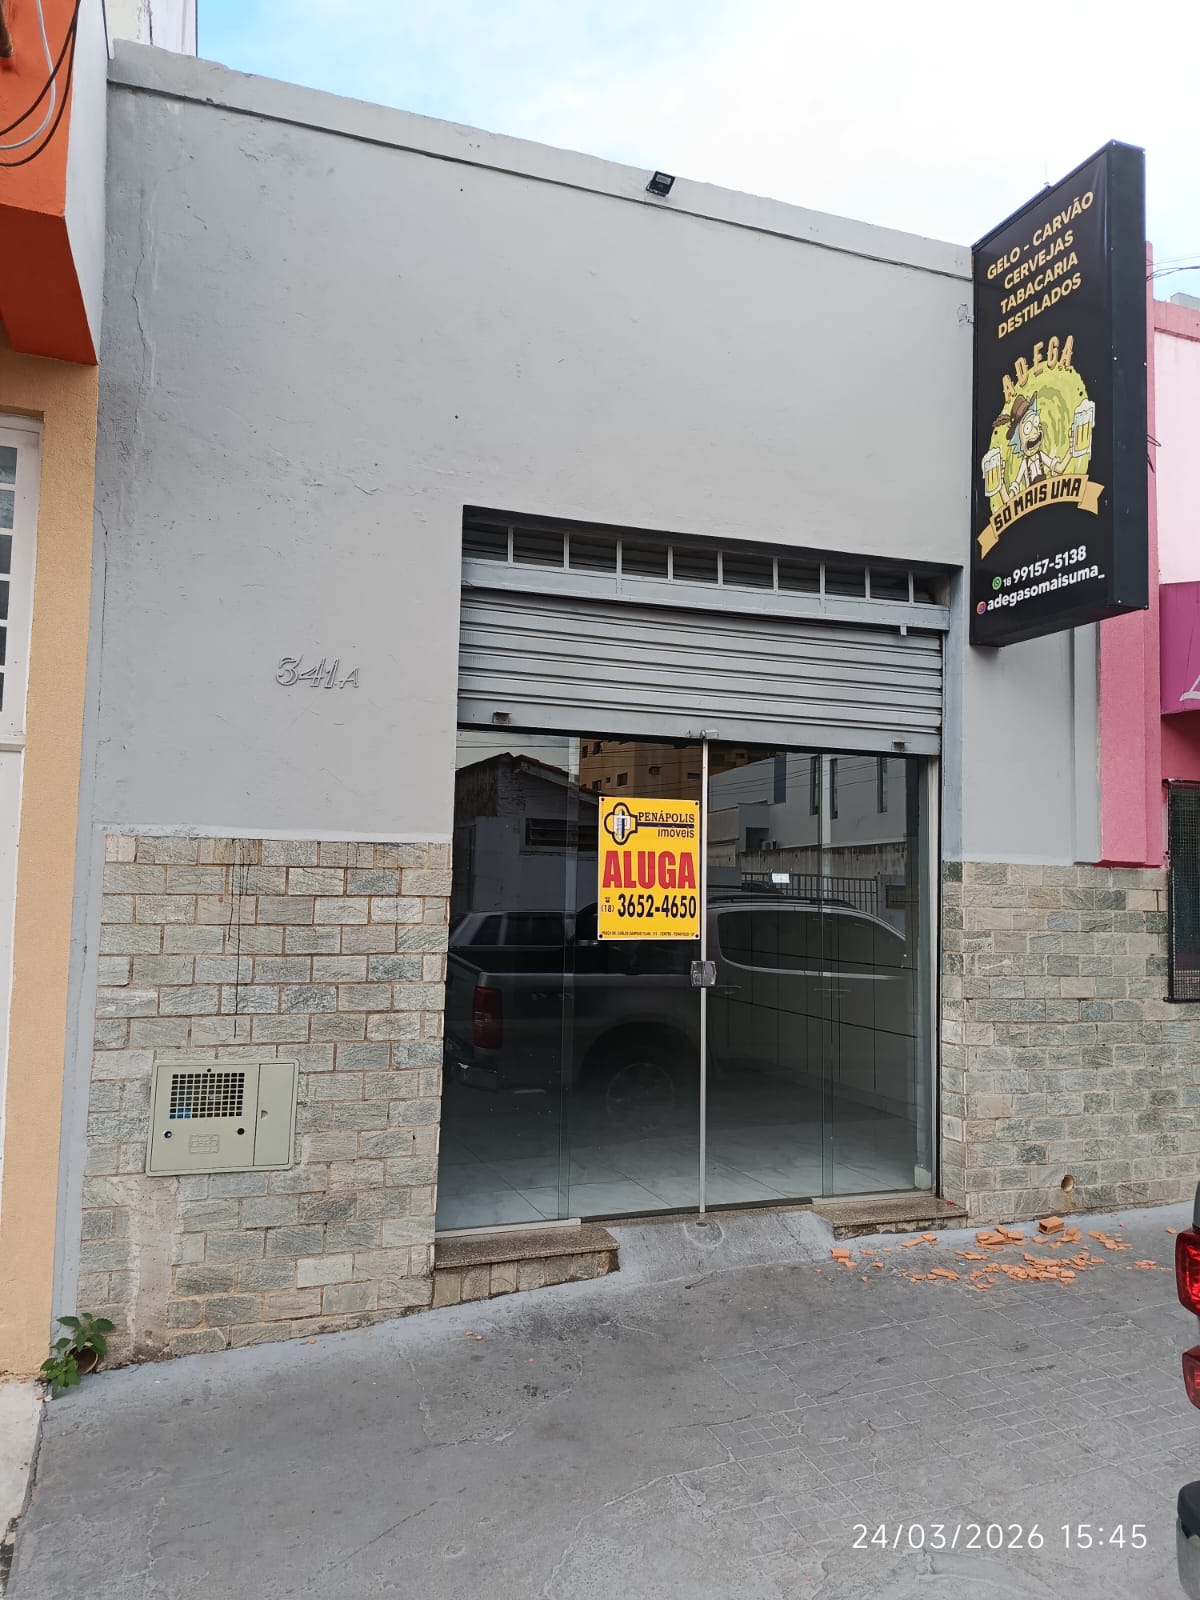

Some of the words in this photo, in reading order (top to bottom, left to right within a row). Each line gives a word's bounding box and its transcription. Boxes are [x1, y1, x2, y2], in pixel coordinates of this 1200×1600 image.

[987, 246, 1020, 280] GELO
[1032, 191, 1094, 246] CARVÃO
[1004, 230, 1074, 289] CERVEJAS
[1000, 251, 1079, 314] TABACARIA
[998, 273, 1082, 339] DESTILADOS
[1002, 335, 1074, 403] ADEGA
[1014, 483, 1048, 515] MAIS
[1051, 477, 1082, 499] UMA
[987, 565, 1105, 611] adegasomaisuma_
[1003, 577, 1012, 588] 18
[1012, 545, 1087, 583] 99157-5138
[638, 810, 695, 824] PENÁPOLIS
[657, 825, 695, 839] imóveis
[602, 850, 697, 889] ALUGA
[600, 904, 615, 913] (18)
[617, 893, 697, 919] 3652-4650
